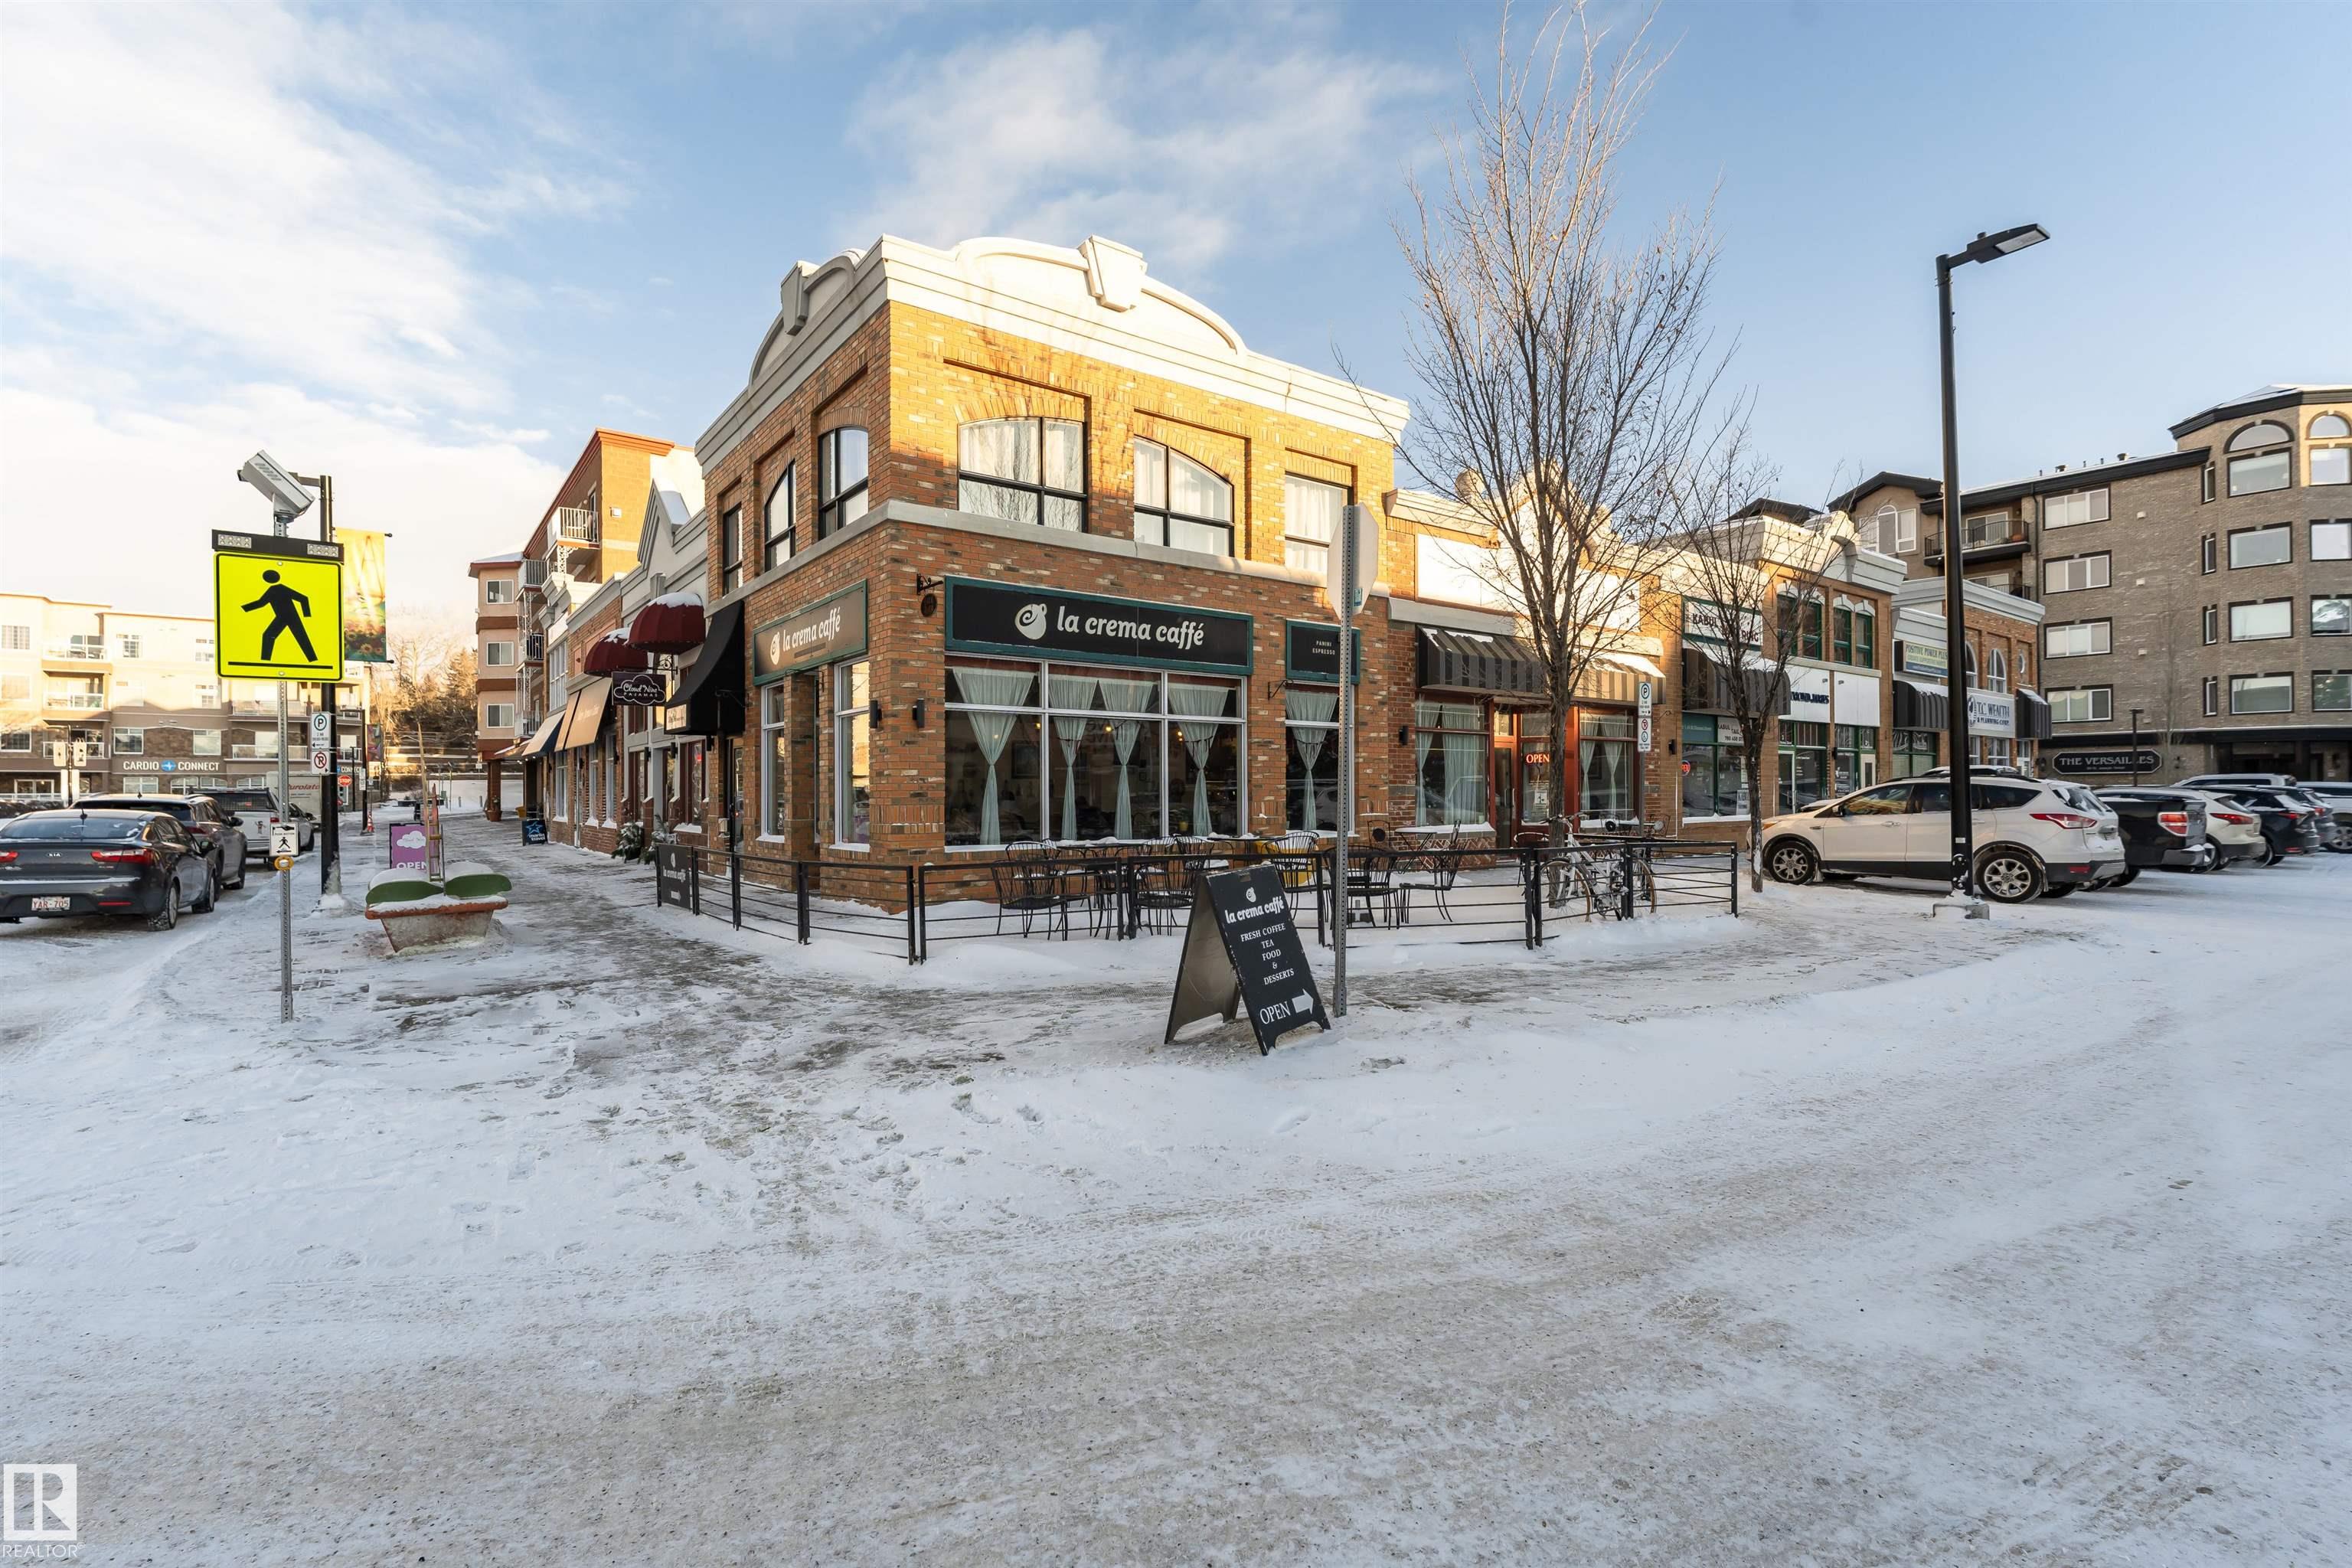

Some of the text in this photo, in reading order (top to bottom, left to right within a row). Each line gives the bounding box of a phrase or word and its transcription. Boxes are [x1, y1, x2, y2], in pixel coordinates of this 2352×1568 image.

[782, 606, 841, 652] la crema caffé
[1057, 606, 1205, 649] la crema caffé
[623, 683, 658, 693] Cloud Nine
[1988, 703, 2010, 717] WEALTH
[1526, 753, 1550, 763] OPEN
[2059, 756, 2154, 766] THE VERSAILES
[122, 761, 220, 771] CARDIO CONNECT
[1225, 896, 1285, 924] la crema caffé
[1240, 923, 1286, 942] FRESH COFFEE
[1261, 939, 1275, 949] TEA
[1262, 949, 1282, 961] FOOD
[1263, 968, 1295, 985] DESSERTS
[1259, 1001, 1291, 1024] OPEN
